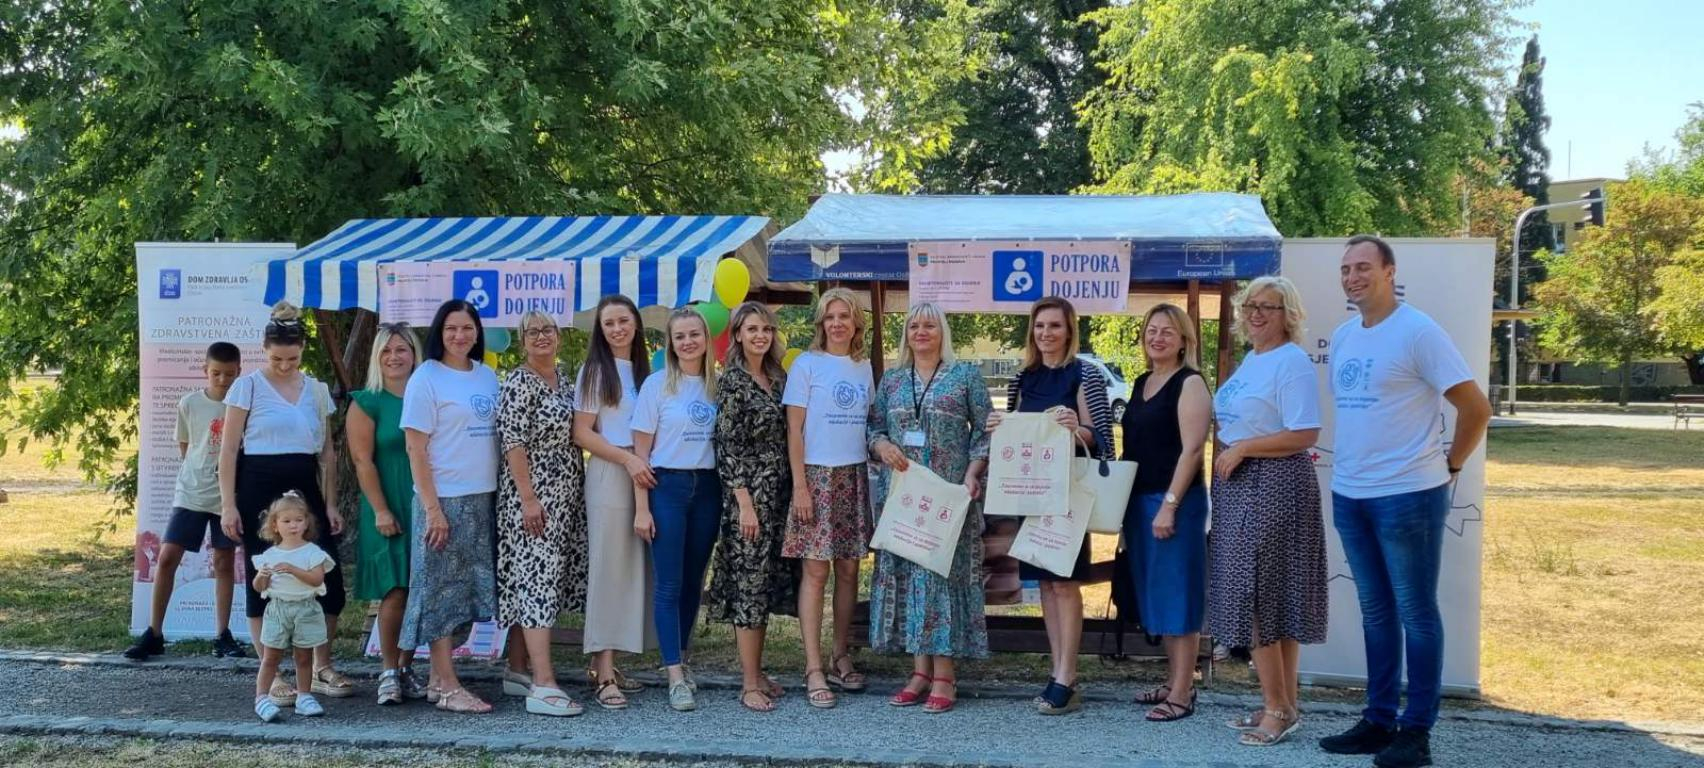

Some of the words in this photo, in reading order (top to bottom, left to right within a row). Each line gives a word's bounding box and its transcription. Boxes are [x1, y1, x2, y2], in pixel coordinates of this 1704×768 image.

[1051, 254, 1120, 272] POTPORA
[1177, 270, 1212, 278] European
[188, 276, 204, 284] DOM
[205, 276, 238, 284] ZDRAVLJA
[505, 274, 565, 290] POTPORA
[1051, 280, 1119, 298] DOJENJU
[505, 298, 564, 315] DOJENJU
[178, 315, 251, 326] PATRONAŽNA
[152, 328, 230, 338] ZDRAVSTVENA
[1318, 338, 1330, 348] D
